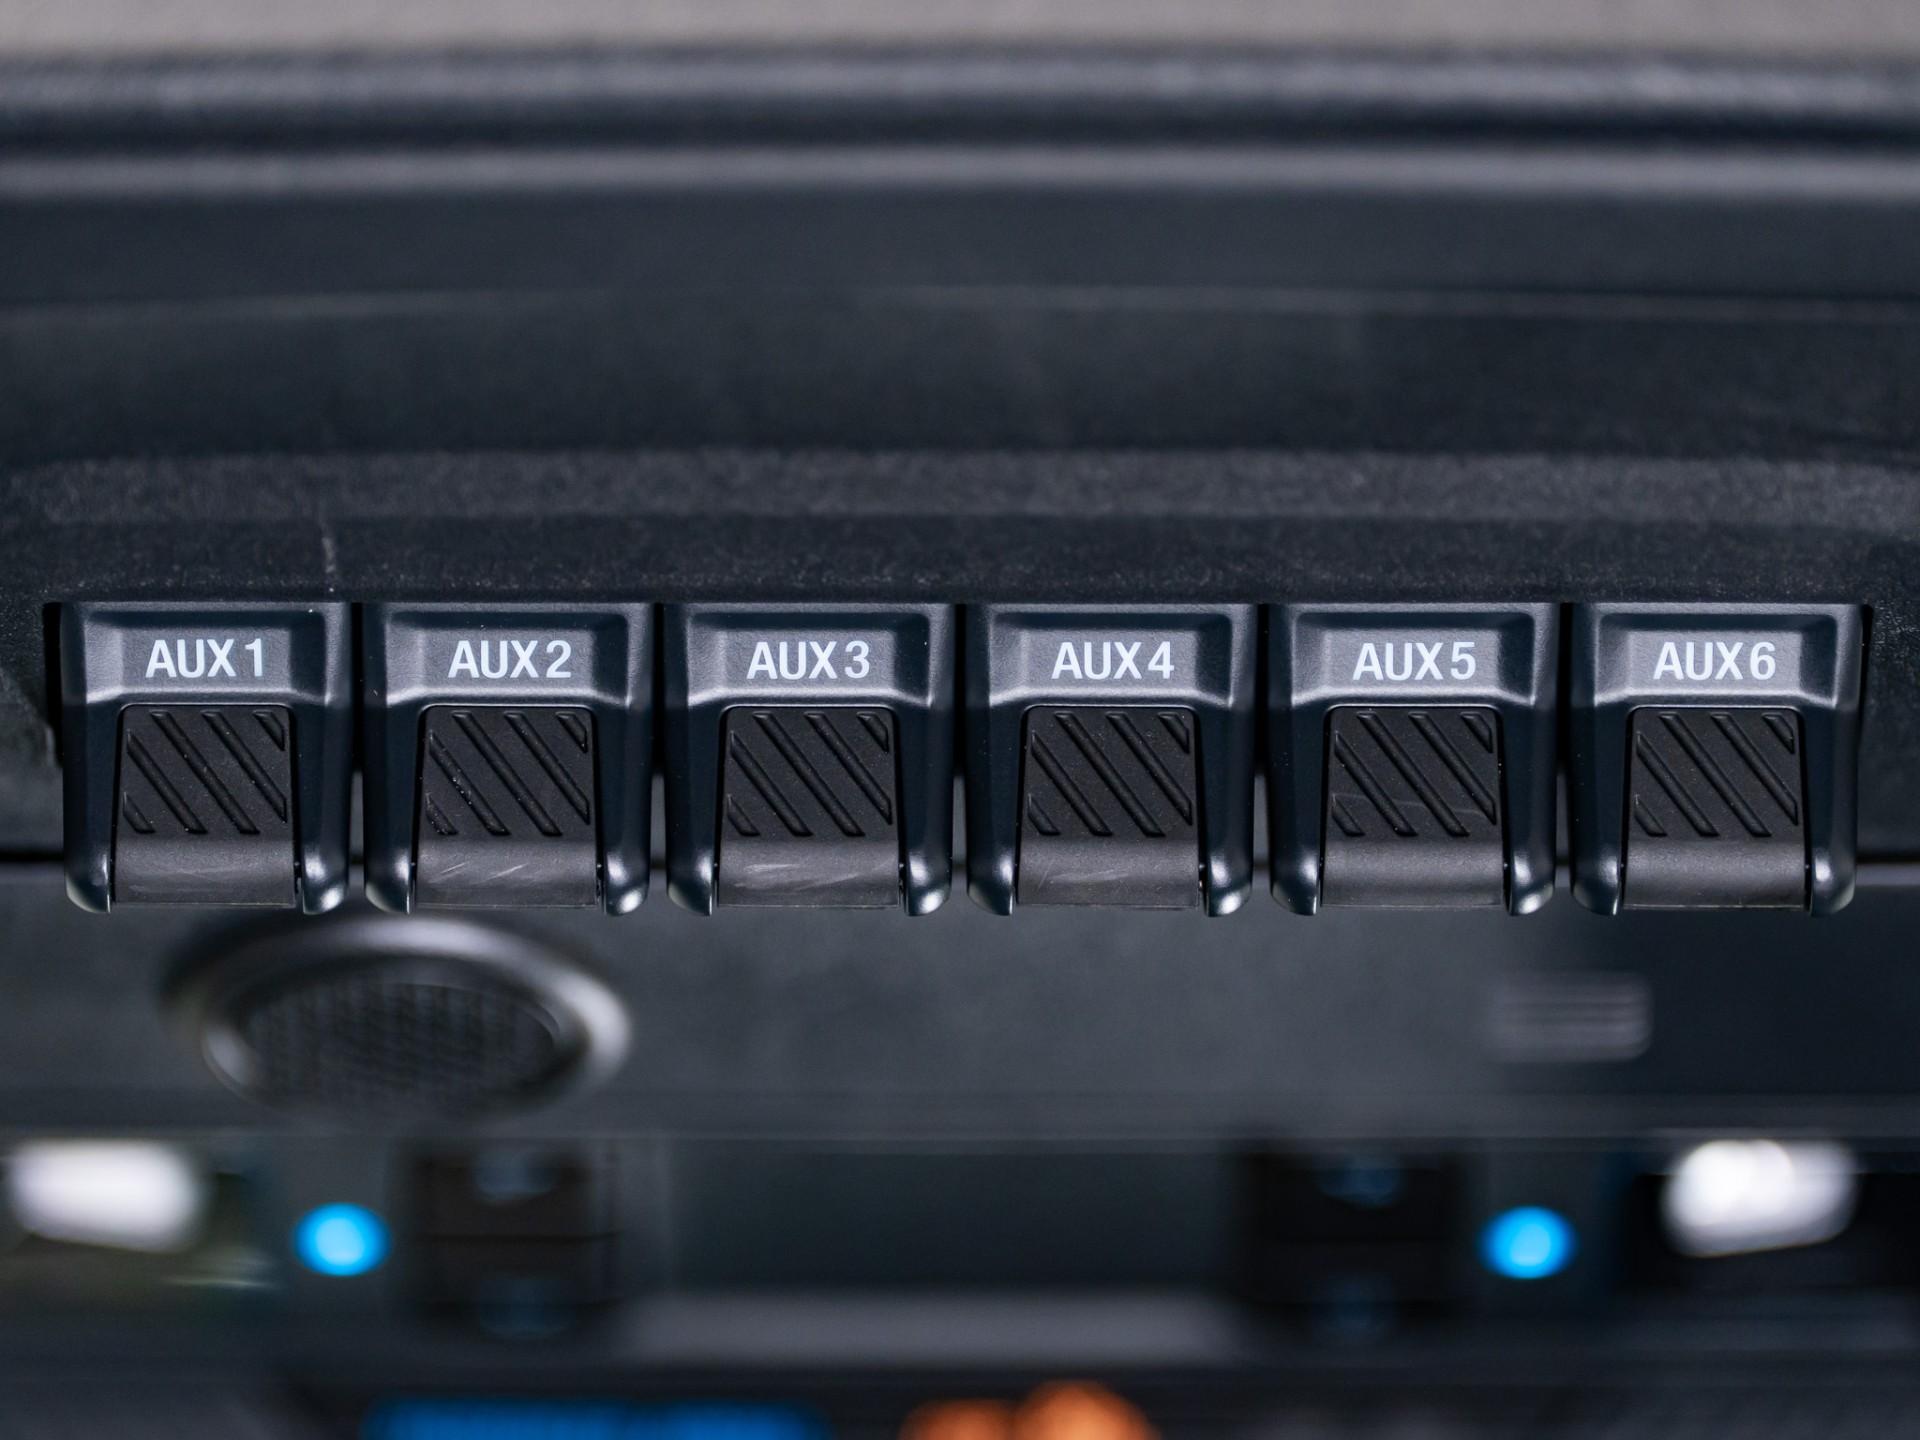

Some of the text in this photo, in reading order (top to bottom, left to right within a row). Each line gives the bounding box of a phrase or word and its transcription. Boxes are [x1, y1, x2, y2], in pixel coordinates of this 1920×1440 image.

[244, 637, 264, 678] 1
[545, 639, 572, 679] 2
[844, 640, 871, 680] 3
[1147, 640, 1176, 681] 4
[1449, 640, 1478, 681] 5
[1748, 640, 1777, 681] 6
